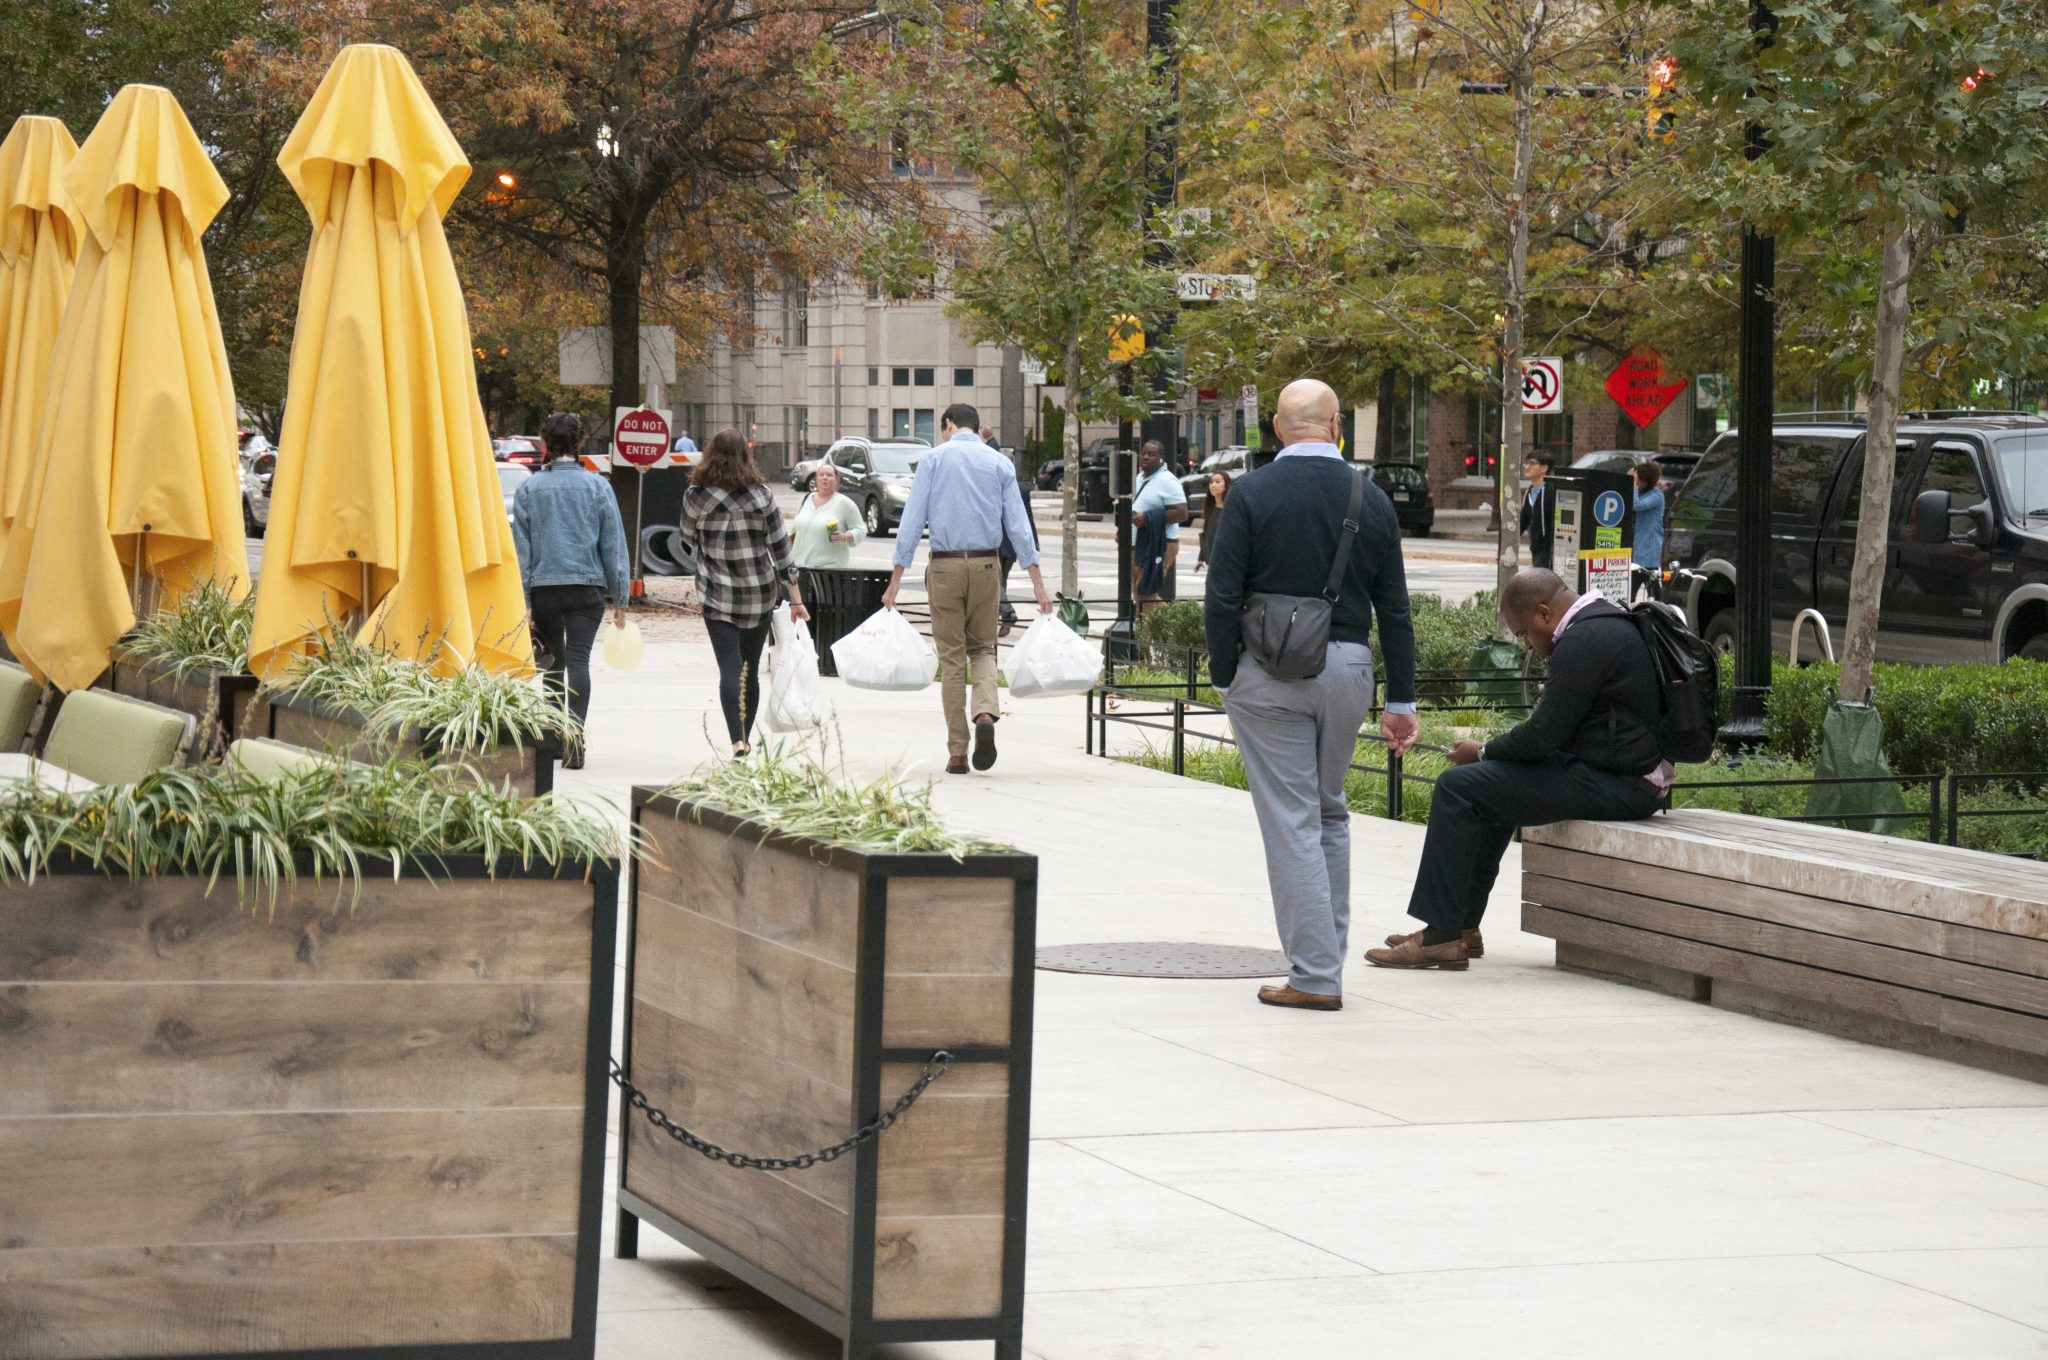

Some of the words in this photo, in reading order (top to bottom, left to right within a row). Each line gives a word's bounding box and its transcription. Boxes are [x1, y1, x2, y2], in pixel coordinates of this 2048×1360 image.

[1629, 359, 1658, 371] ROAD
[1629, 377, 1658, 390] WORK
[1625, 394, 1663, 407] AHEAD
[624, 419, 638, 430] DO
[642, 420, 663, 431] NOT
[626, 444, 657, 457] ENTER
[1603, 497, 1618, 521] P
[1592, 557, 1604, 570] NO
[1607, 557, 1627, 567] PARKING
